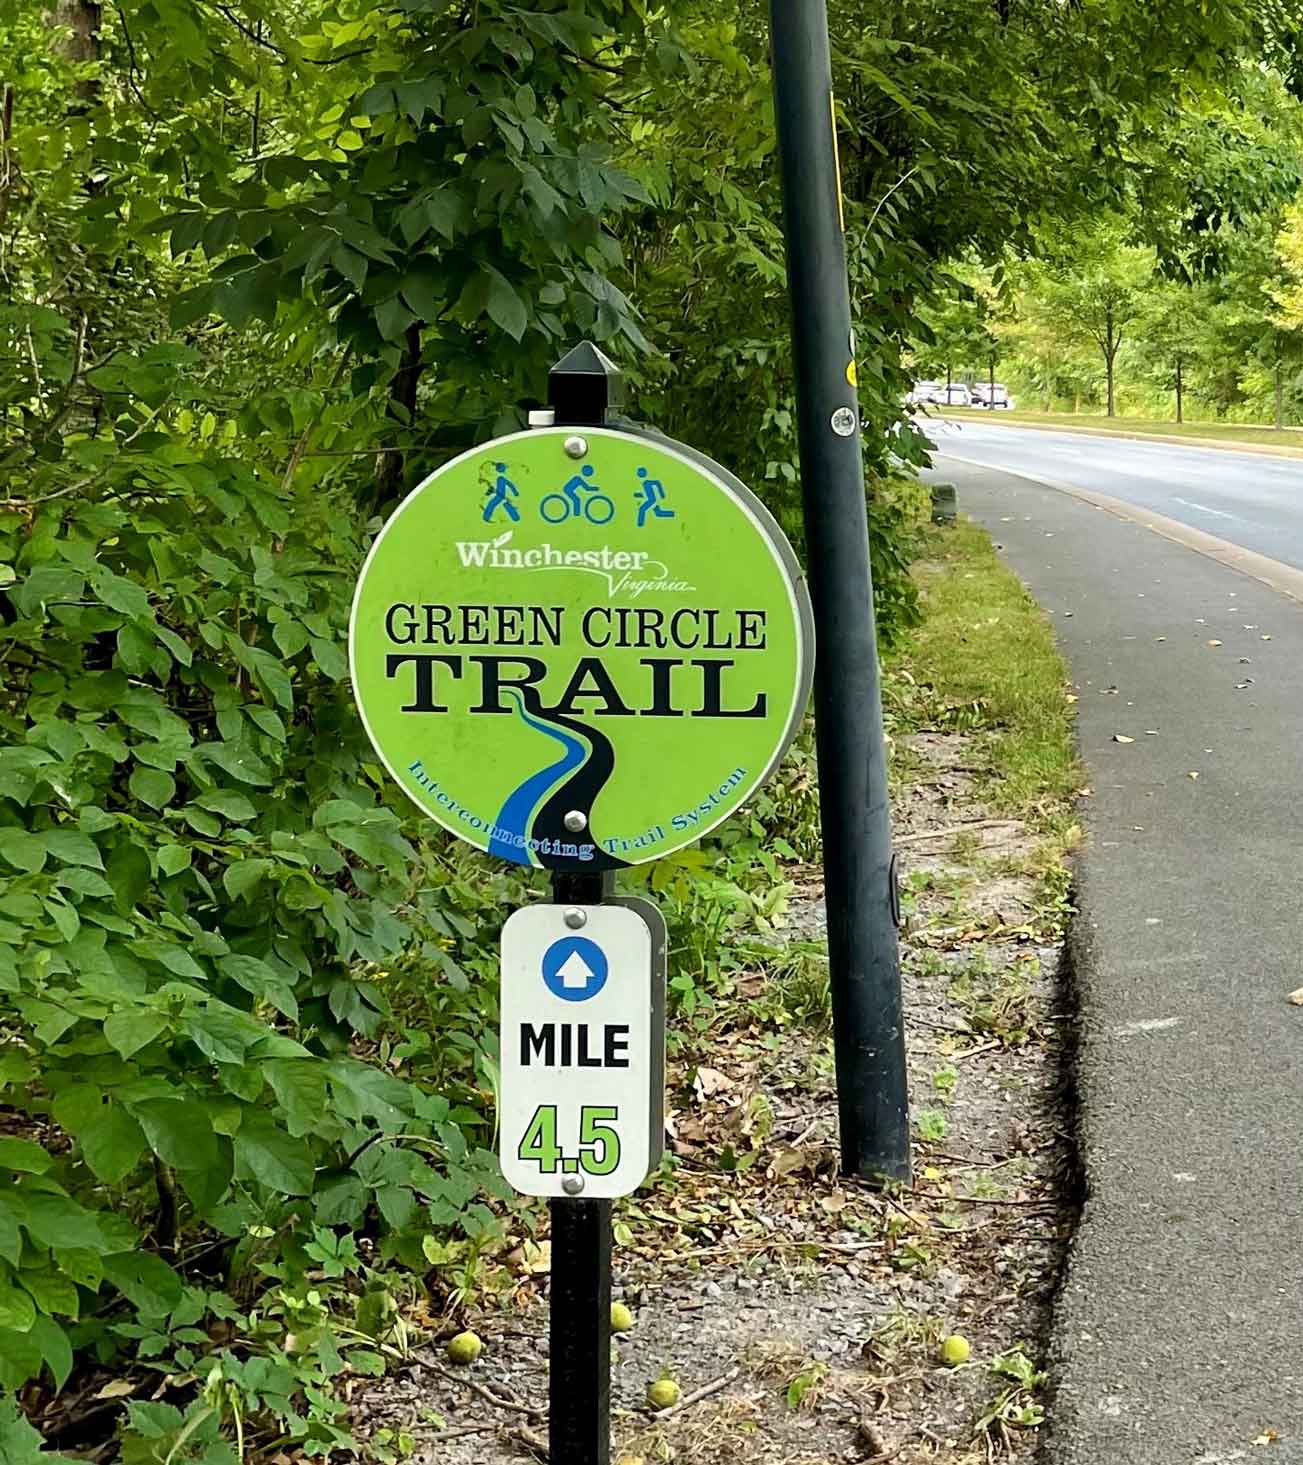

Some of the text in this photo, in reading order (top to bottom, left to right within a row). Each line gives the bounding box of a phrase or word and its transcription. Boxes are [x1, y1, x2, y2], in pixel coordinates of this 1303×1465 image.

[456, 531, 649, 571] Winchester
[606, 570, 697, 599] Virginia
[385, 603, 767, 650] GREEN CIRCLE
[386, 654, 768, 718] TRAIL
[408, 760, 748, 862] Interconnecting Trail System
[520, 1022, 629, 1068] MILE
[518, 1104, 621, 1176] 4.5
